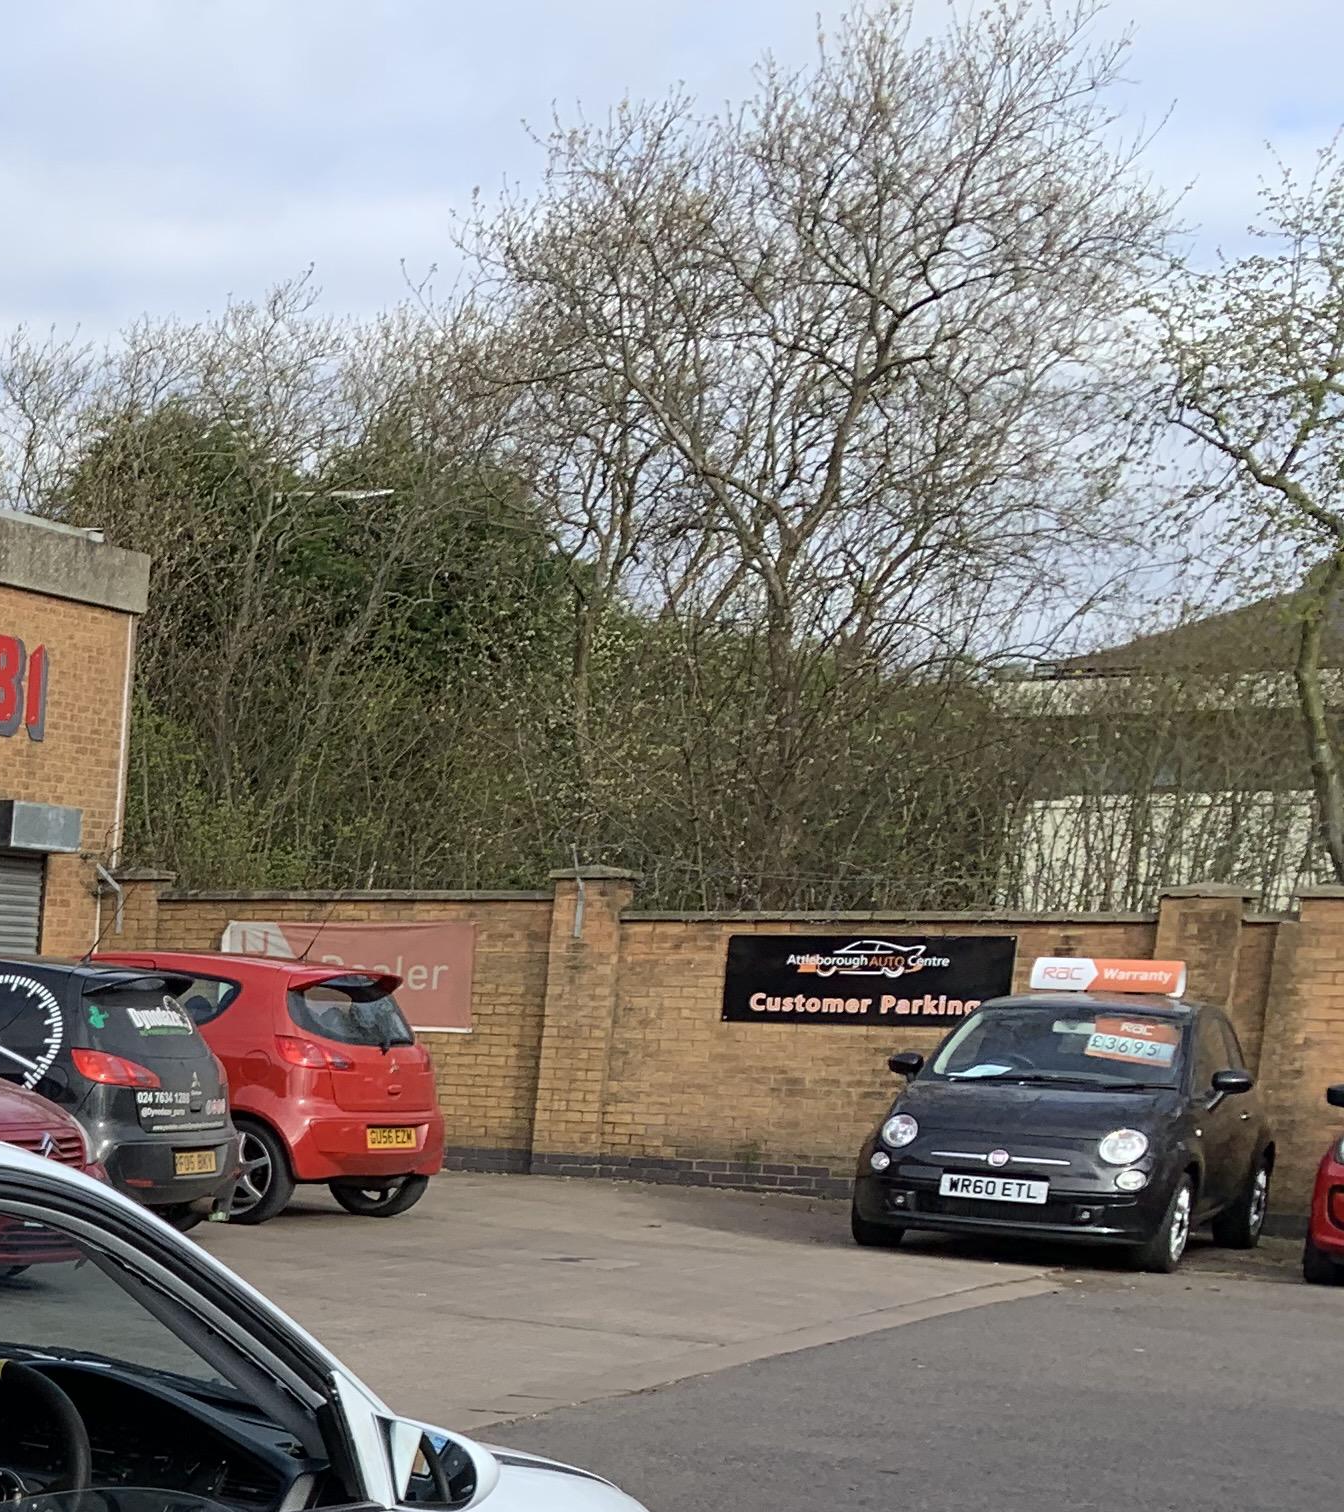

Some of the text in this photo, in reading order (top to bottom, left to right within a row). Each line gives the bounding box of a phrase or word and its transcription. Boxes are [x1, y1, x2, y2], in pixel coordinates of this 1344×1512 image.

[786, 954, 950, 970] Attleborough AUTO Centre
[1103, 967, 1173, 985] Warranty
[749, 992, 872, 1014] Customer
[1090, 1034, 1158, 1057] £3695
[948, 1177, 1037, 1199] WR60 ETL
